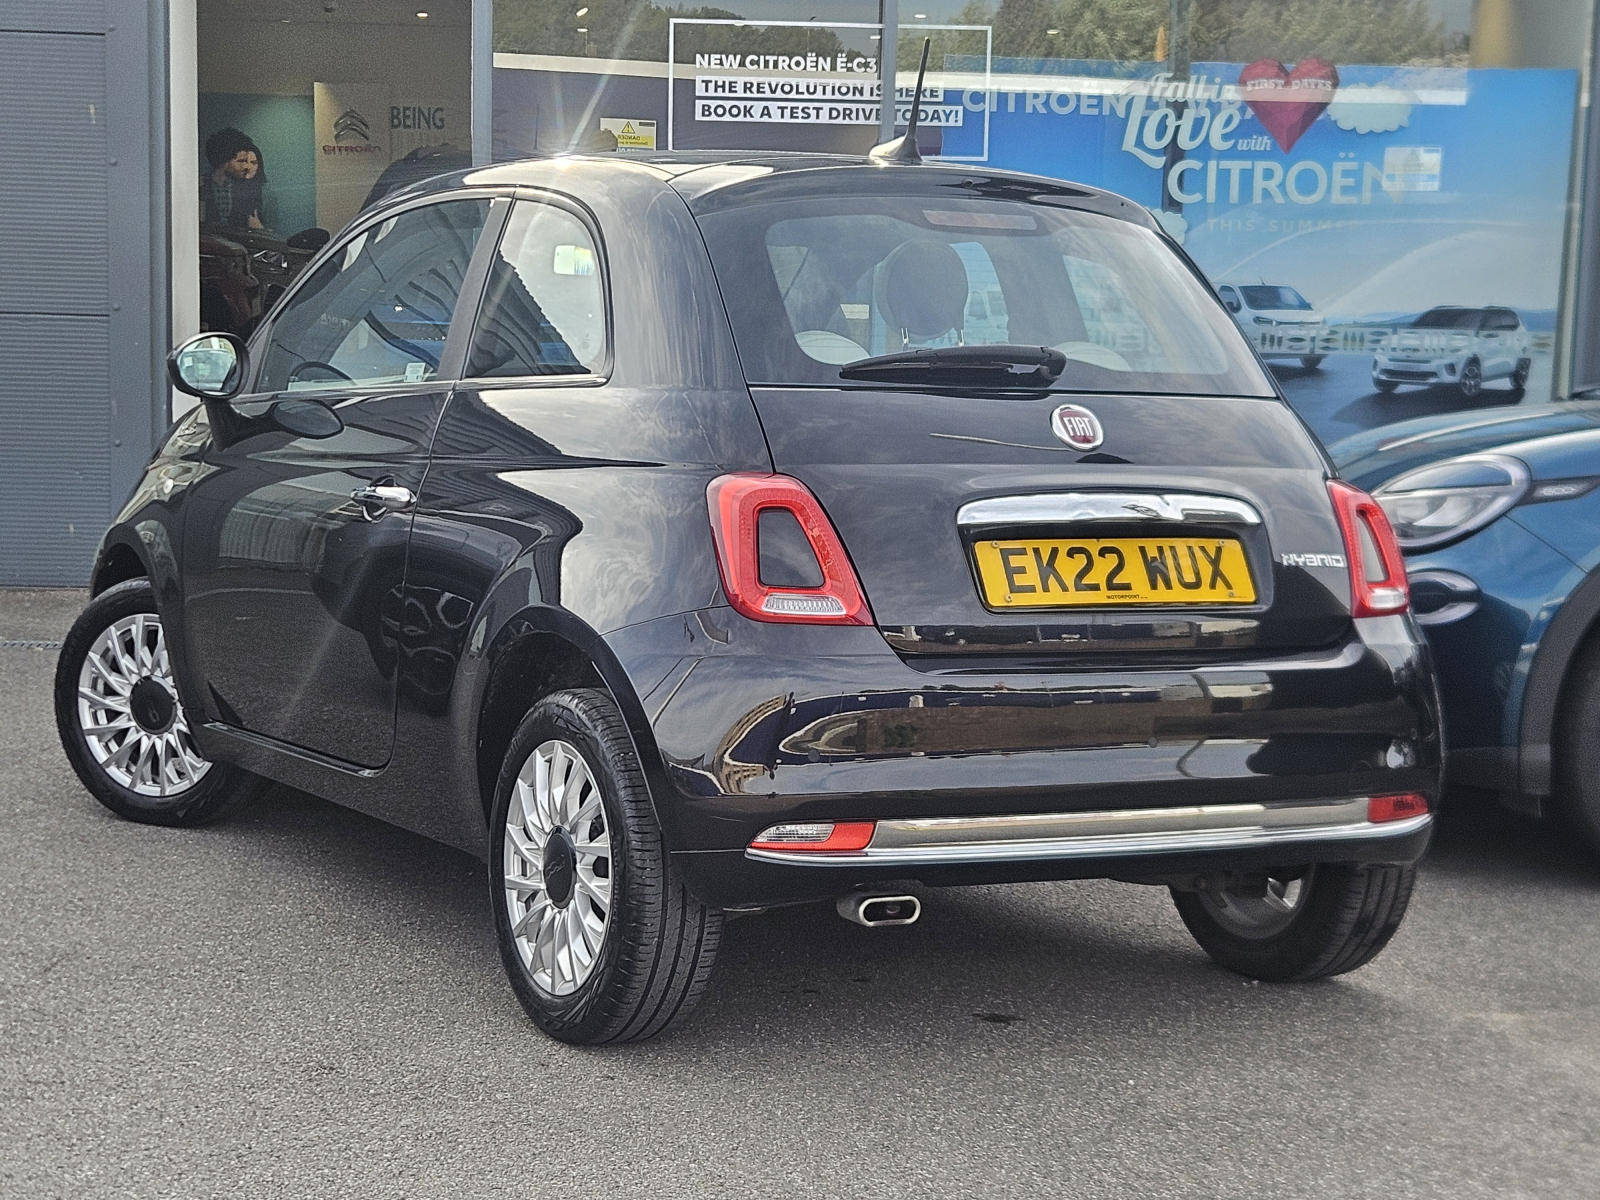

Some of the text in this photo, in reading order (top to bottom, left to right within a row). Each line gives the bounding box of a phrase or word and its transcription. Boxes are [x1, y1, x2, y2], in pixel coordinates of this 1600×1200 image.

[695, 52, 877, 73] NEW CITROËN Ë-C3
[701, 79, 738, 94] THE
[743, 81, 864, 97] REVOLUTION
[1150, 72, 1206, 102] Fall
[1246, 79, 1333, 91] FIRST DATES
[390, 105, 445, 130] BEING
[701, 104, 754, 119] BOOK
[759, 105, 771, 119] A
[777, 106, 823, 121] TEST
[1121, 88, 1243, 169] Love
[1236, 135, 1272, 151] with
[1167, 152, 1405, 206] CITROËN
[1207, 219, 1359, 233] THIS SUMMER
[1063, 416, 1095, 438] FIAT
[1000, 545, 1233, 593] EK22 WUX
[1281, 553, 1344, 568] HYBRID
